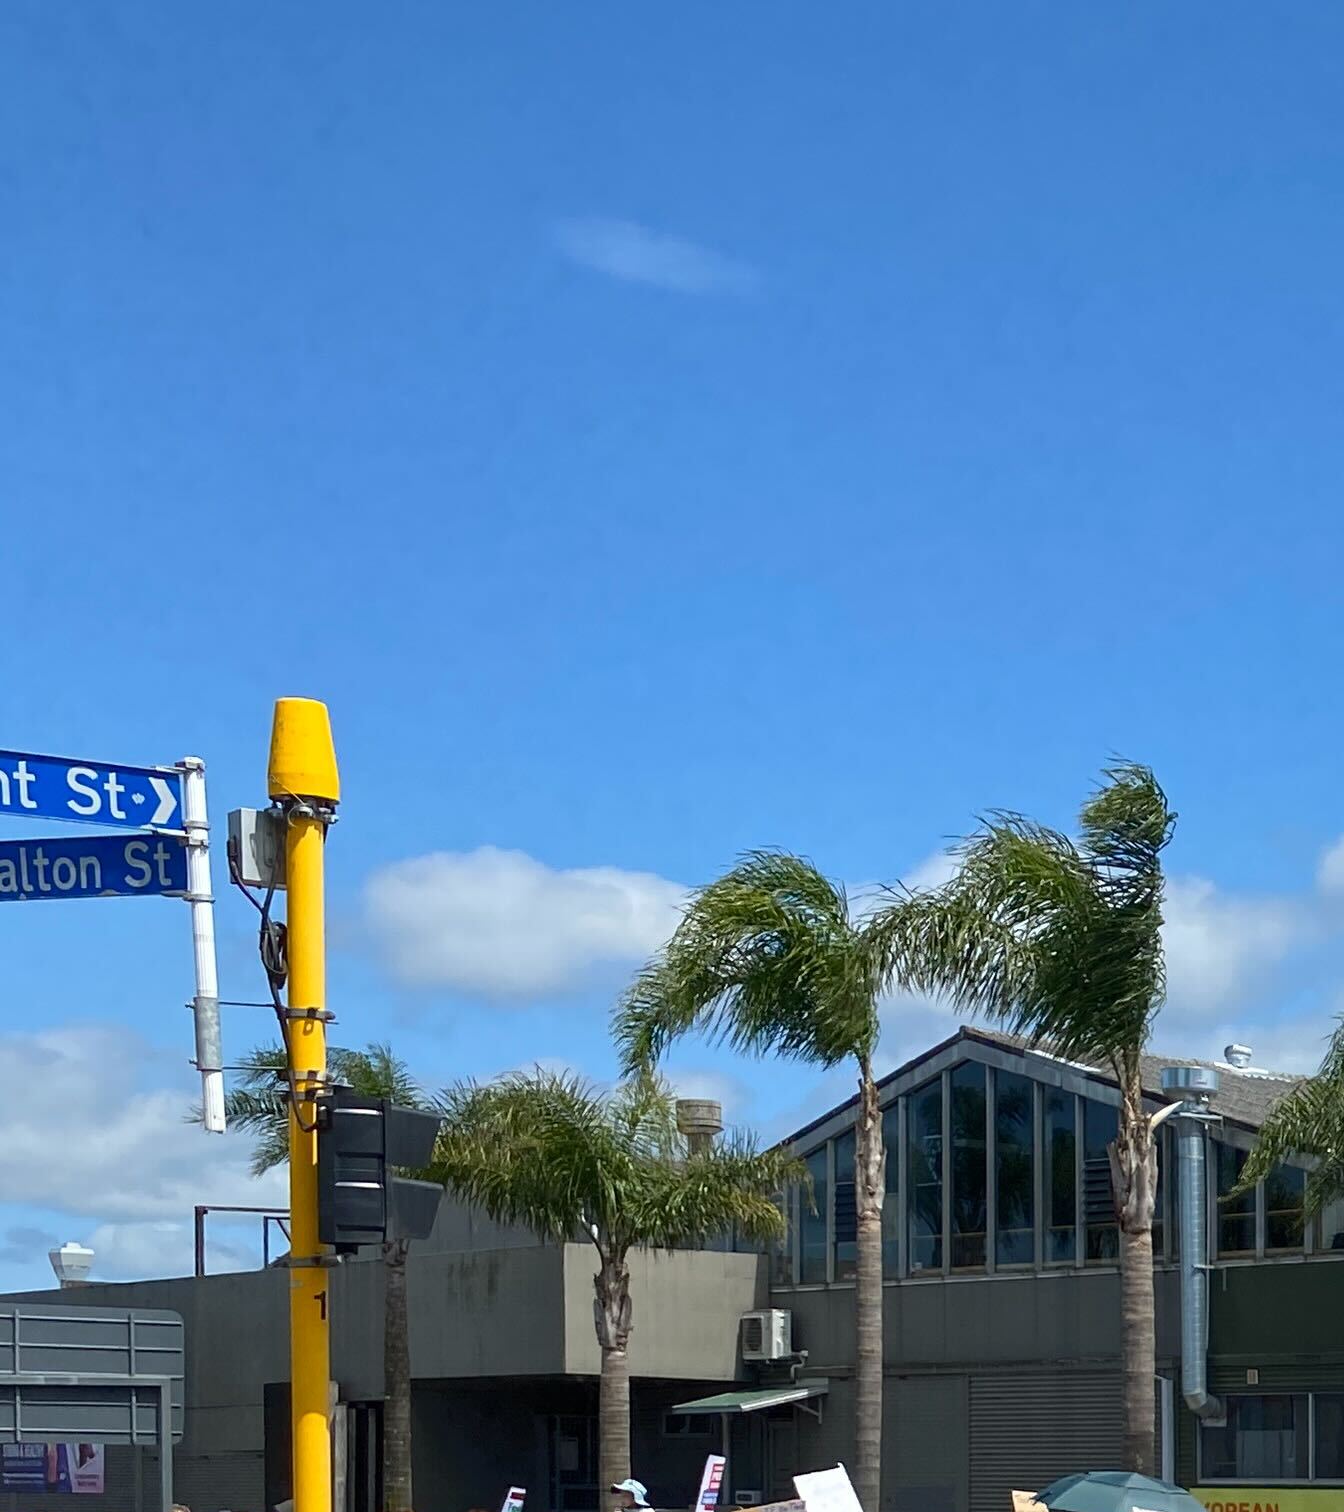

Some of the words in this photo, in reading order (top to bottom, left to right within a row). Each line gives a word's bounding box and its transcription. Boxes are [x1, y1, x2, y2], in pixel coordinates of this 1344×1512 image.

[66, 767, 127, 820] St
[124, 841, 172, 888] St
[313, 1291, 327, 1320] 1
